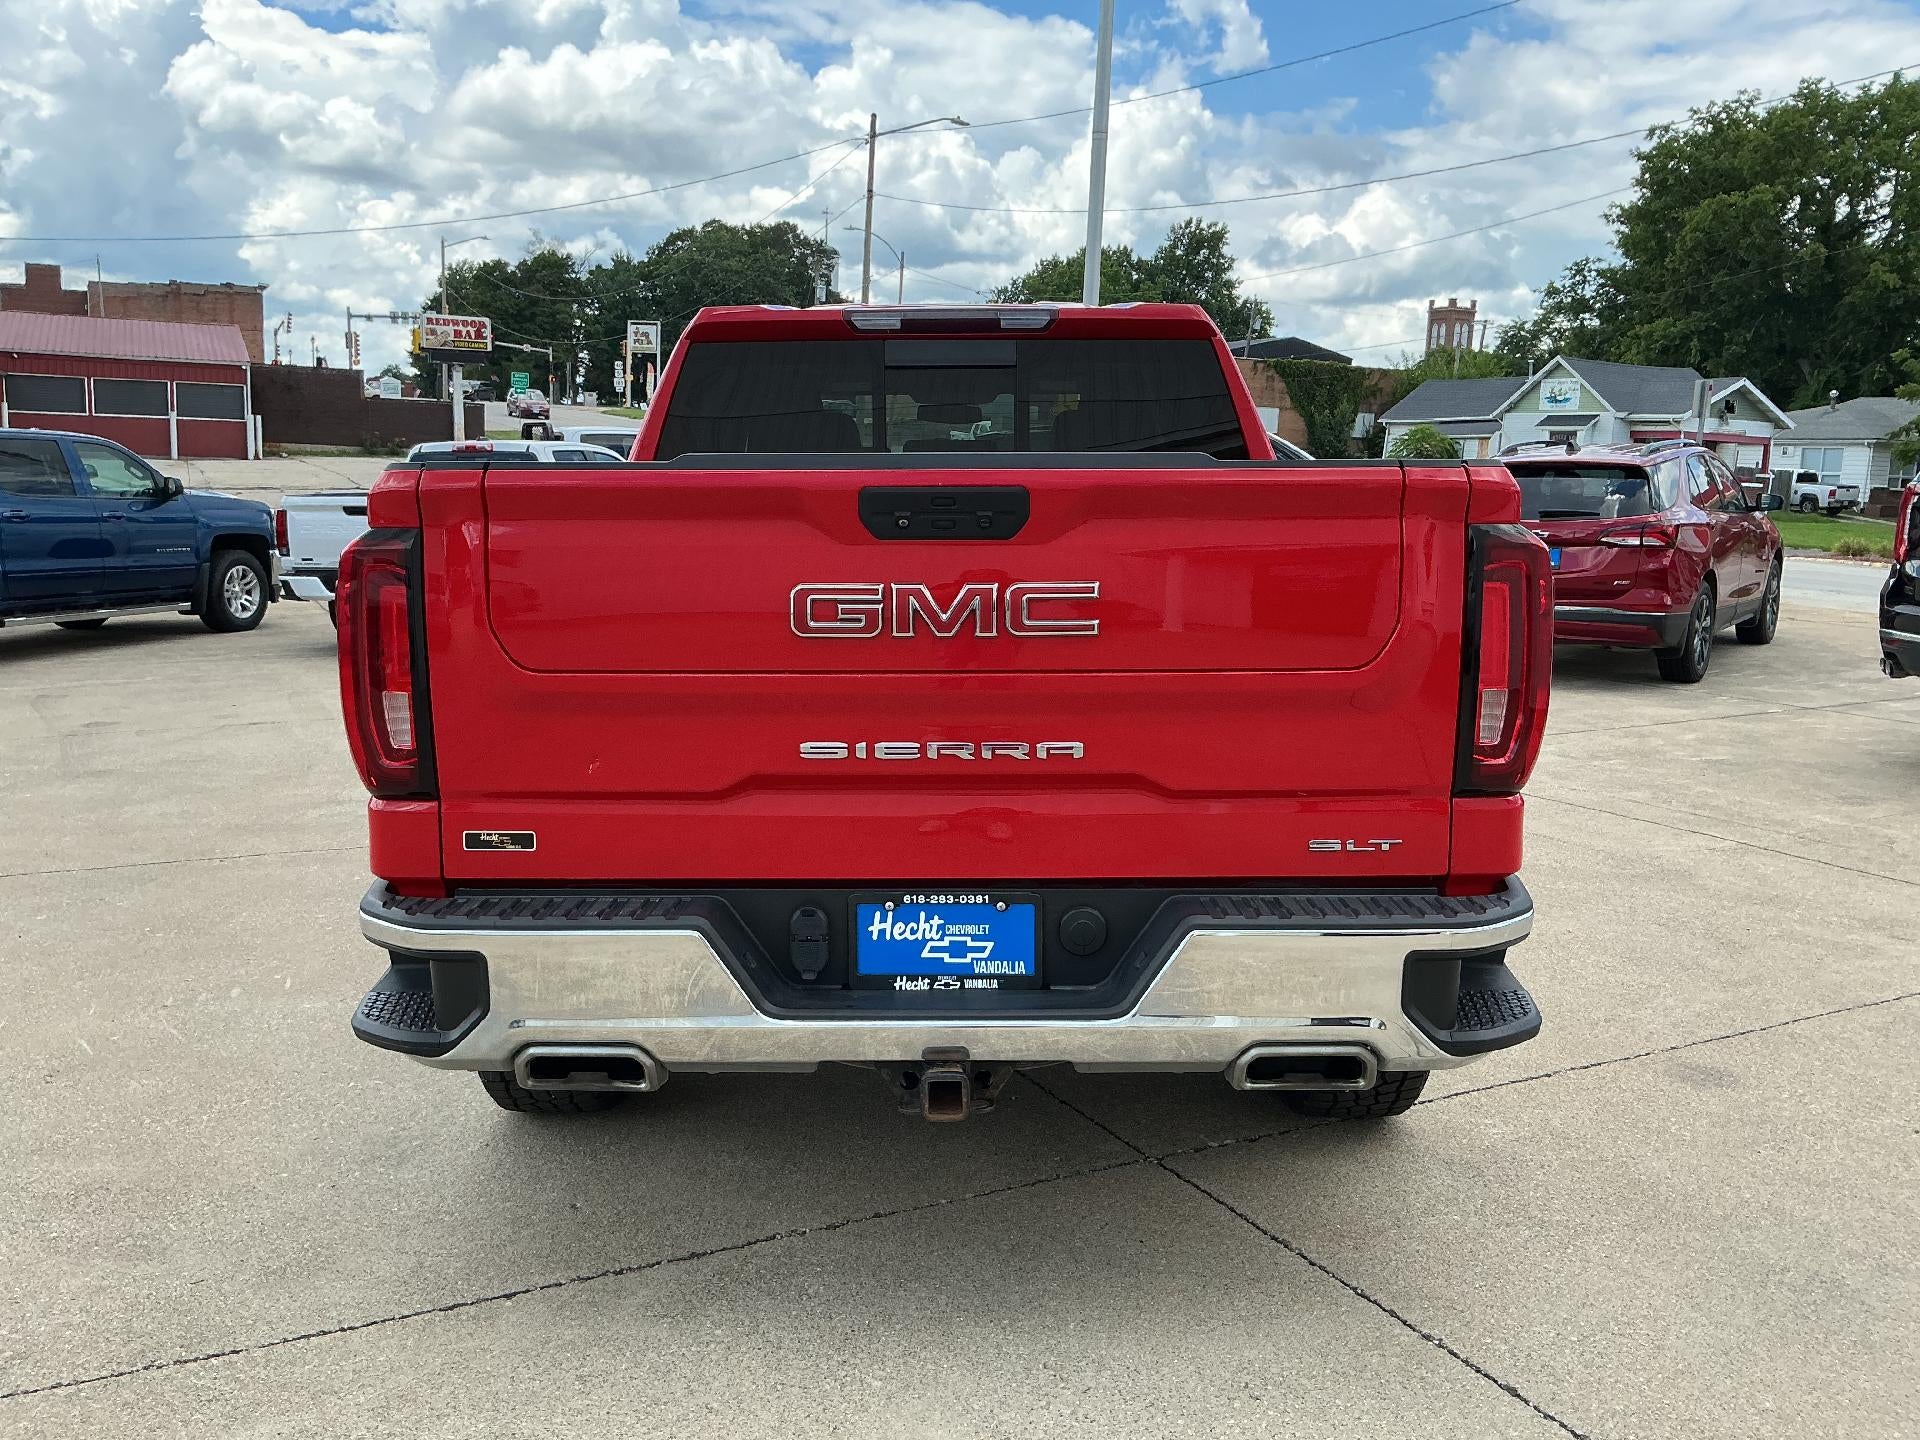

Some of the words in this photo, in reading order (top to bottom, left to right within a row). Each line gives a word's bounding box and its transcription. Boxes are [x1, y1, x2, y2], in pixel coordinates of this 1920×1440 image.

[426, 317, 487, 329] REDWOOD
[453, 329, 484, 340] BAR
[790, 581, 1100, 637] GMC
[799, 741, 1084, 760] SIERRA
[1308, 839, 1402, 851] SLT
[903, 894, 989, 904] 618-283-0381
[868, 910, 945, 941] Hecht
[945, 924, 990, 935] CHEVROLET
[973, 960, 1026, 975] VANDALIA
[894, 976, 931, 991] Hecht
[964, 979, 999, 990] VANDALIA
